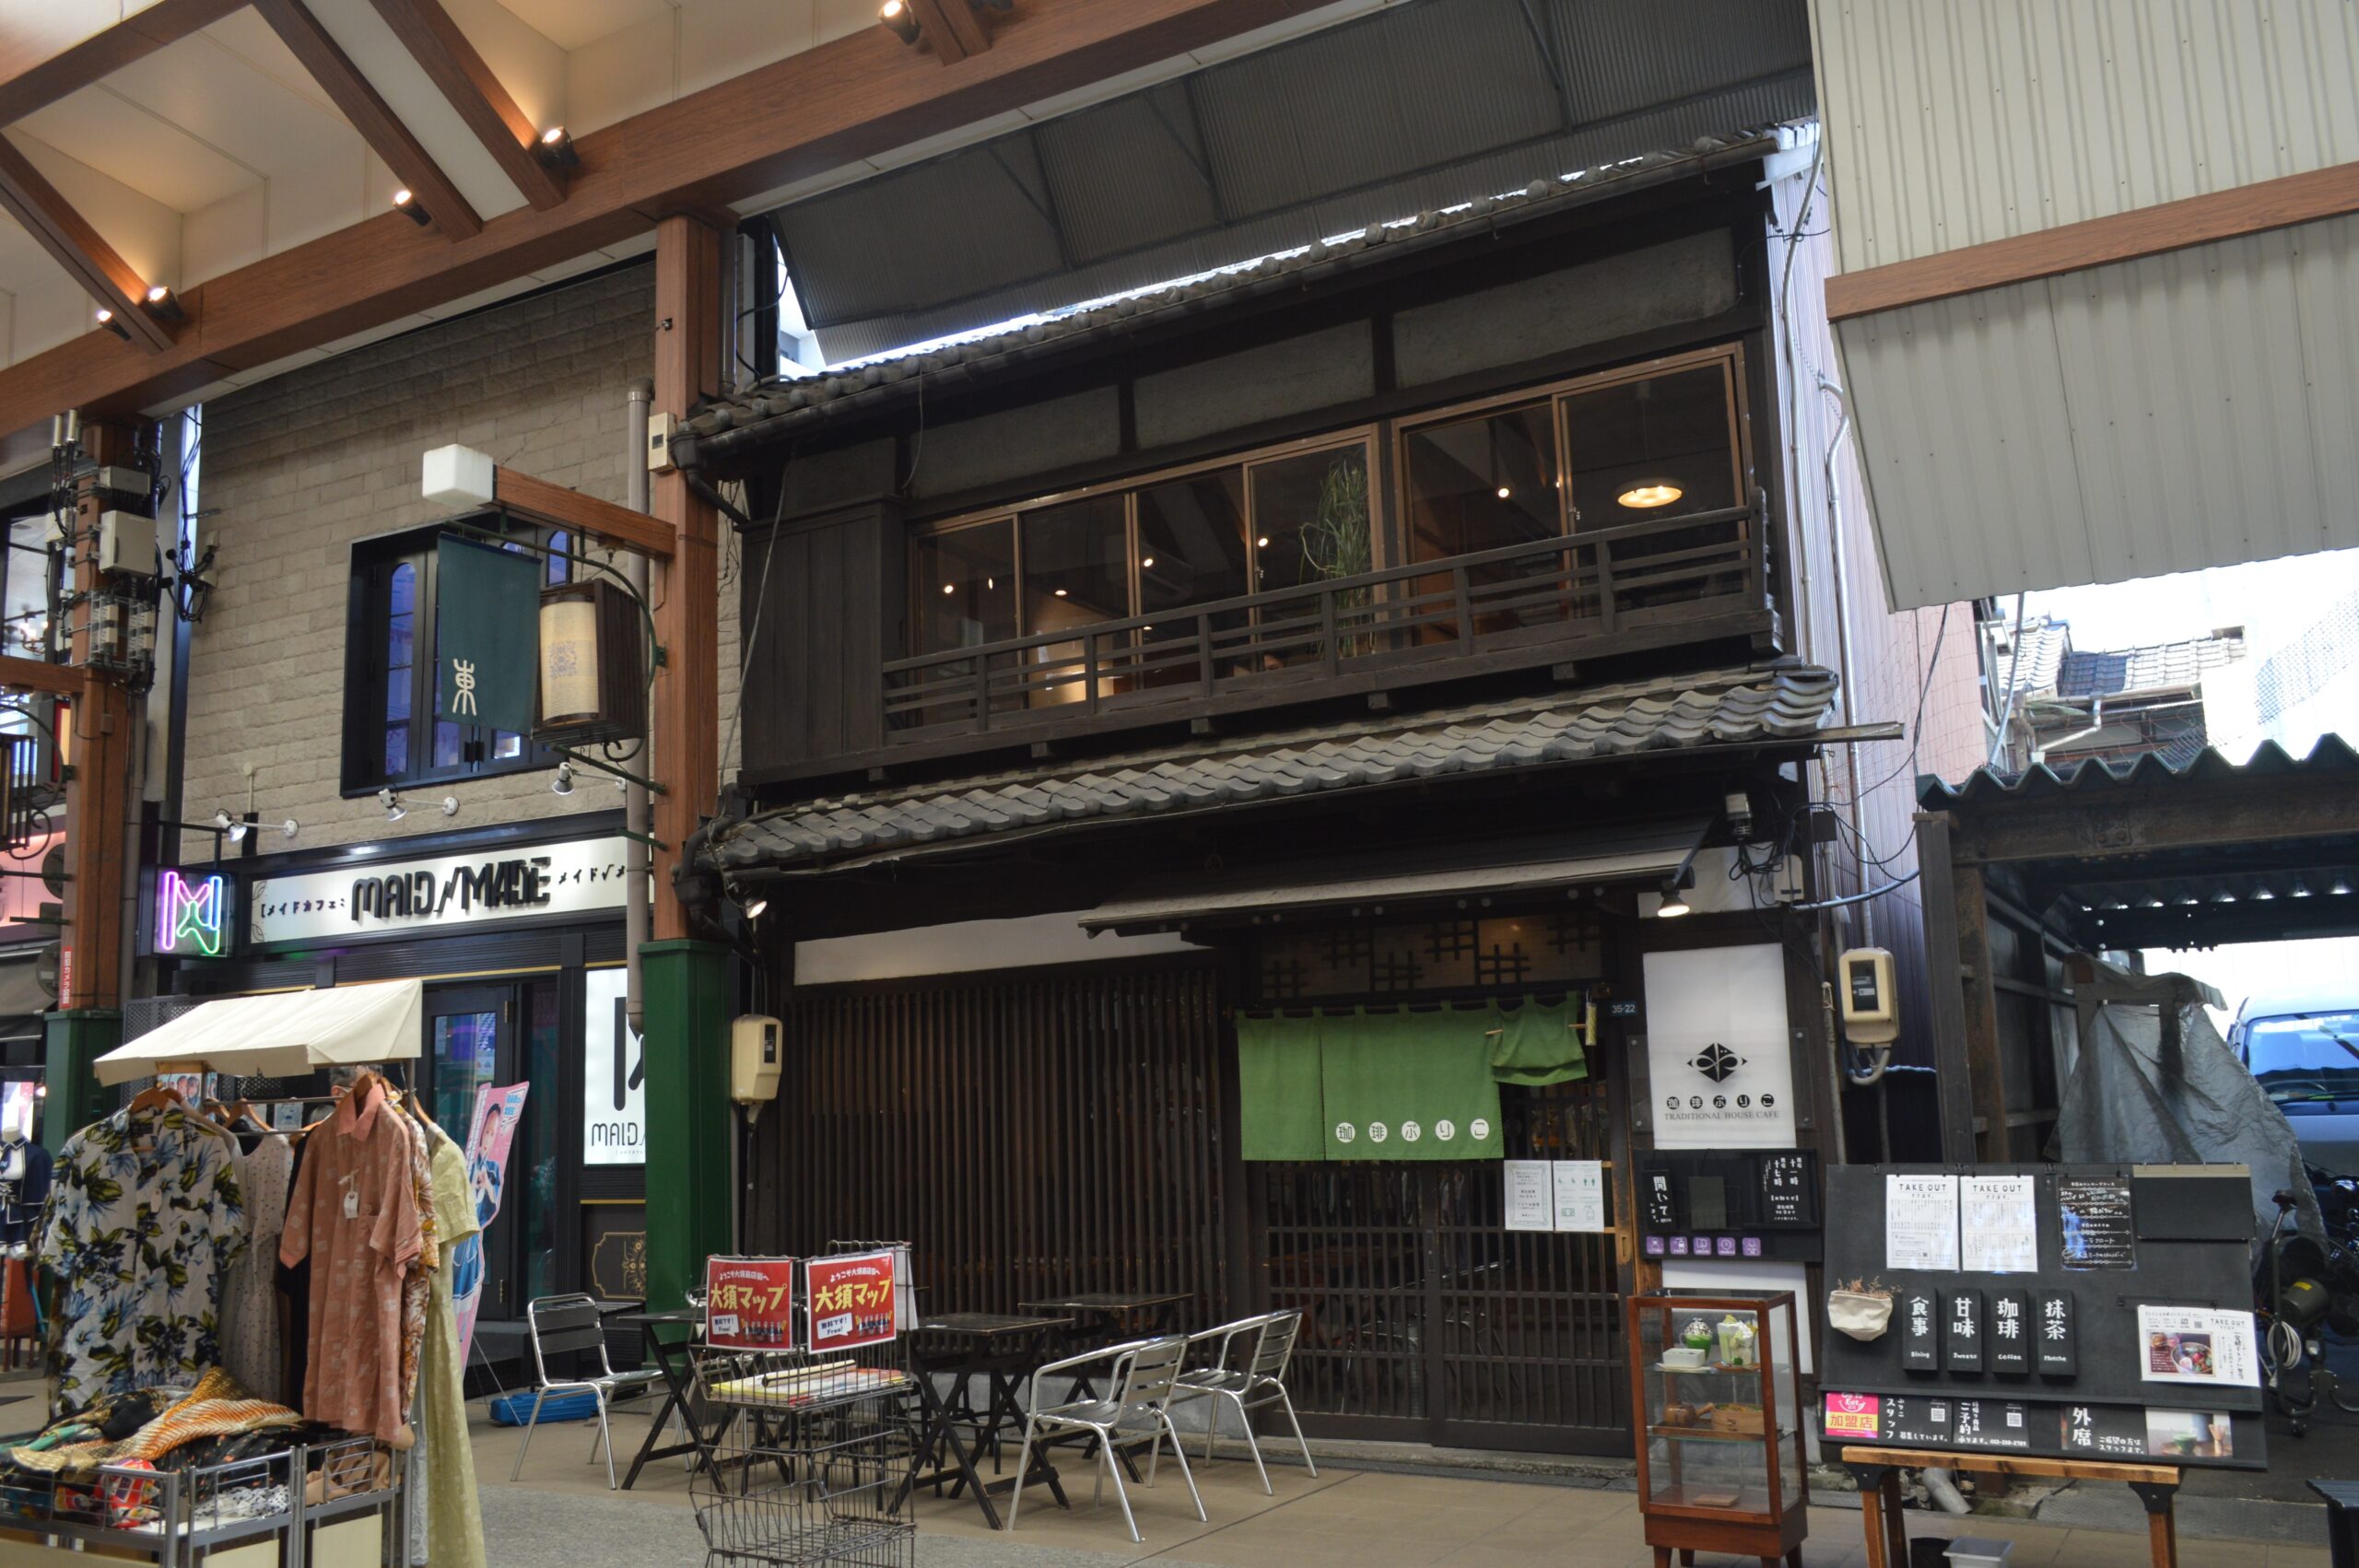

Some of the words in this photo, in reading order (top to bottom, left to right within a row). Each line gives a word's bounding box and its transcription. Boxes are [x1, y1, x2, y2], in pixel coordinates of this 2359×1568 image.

[1664, 1113, 1721, 1121] TRADITIONAL
[1724, 1111, 1753, 1119] HOUSE
[1755, 1110, 1779, 1118] CAFE
[1899, 1183, 1923, 1191] TAKE
[710, 1282, 788, 1315] 大須マップ
[815, 1275, 893, 1313] 大須マップ
[1909, 1296, 1930, 1337] 食事
[1953, 1297, 1976, 1339] 甘味
[1997, 1298, 2020, 1340] 珈琲
[2044, 1299, 2067, 1340] 抹茶
[1910, 1351, 1931, 1359] Dining
[1830, 1415, 1873, 1429] 加盟店
[1885, 1398, 1896, 1439] スタッフ
[2072, 1407, 2093, 1446] 外席
